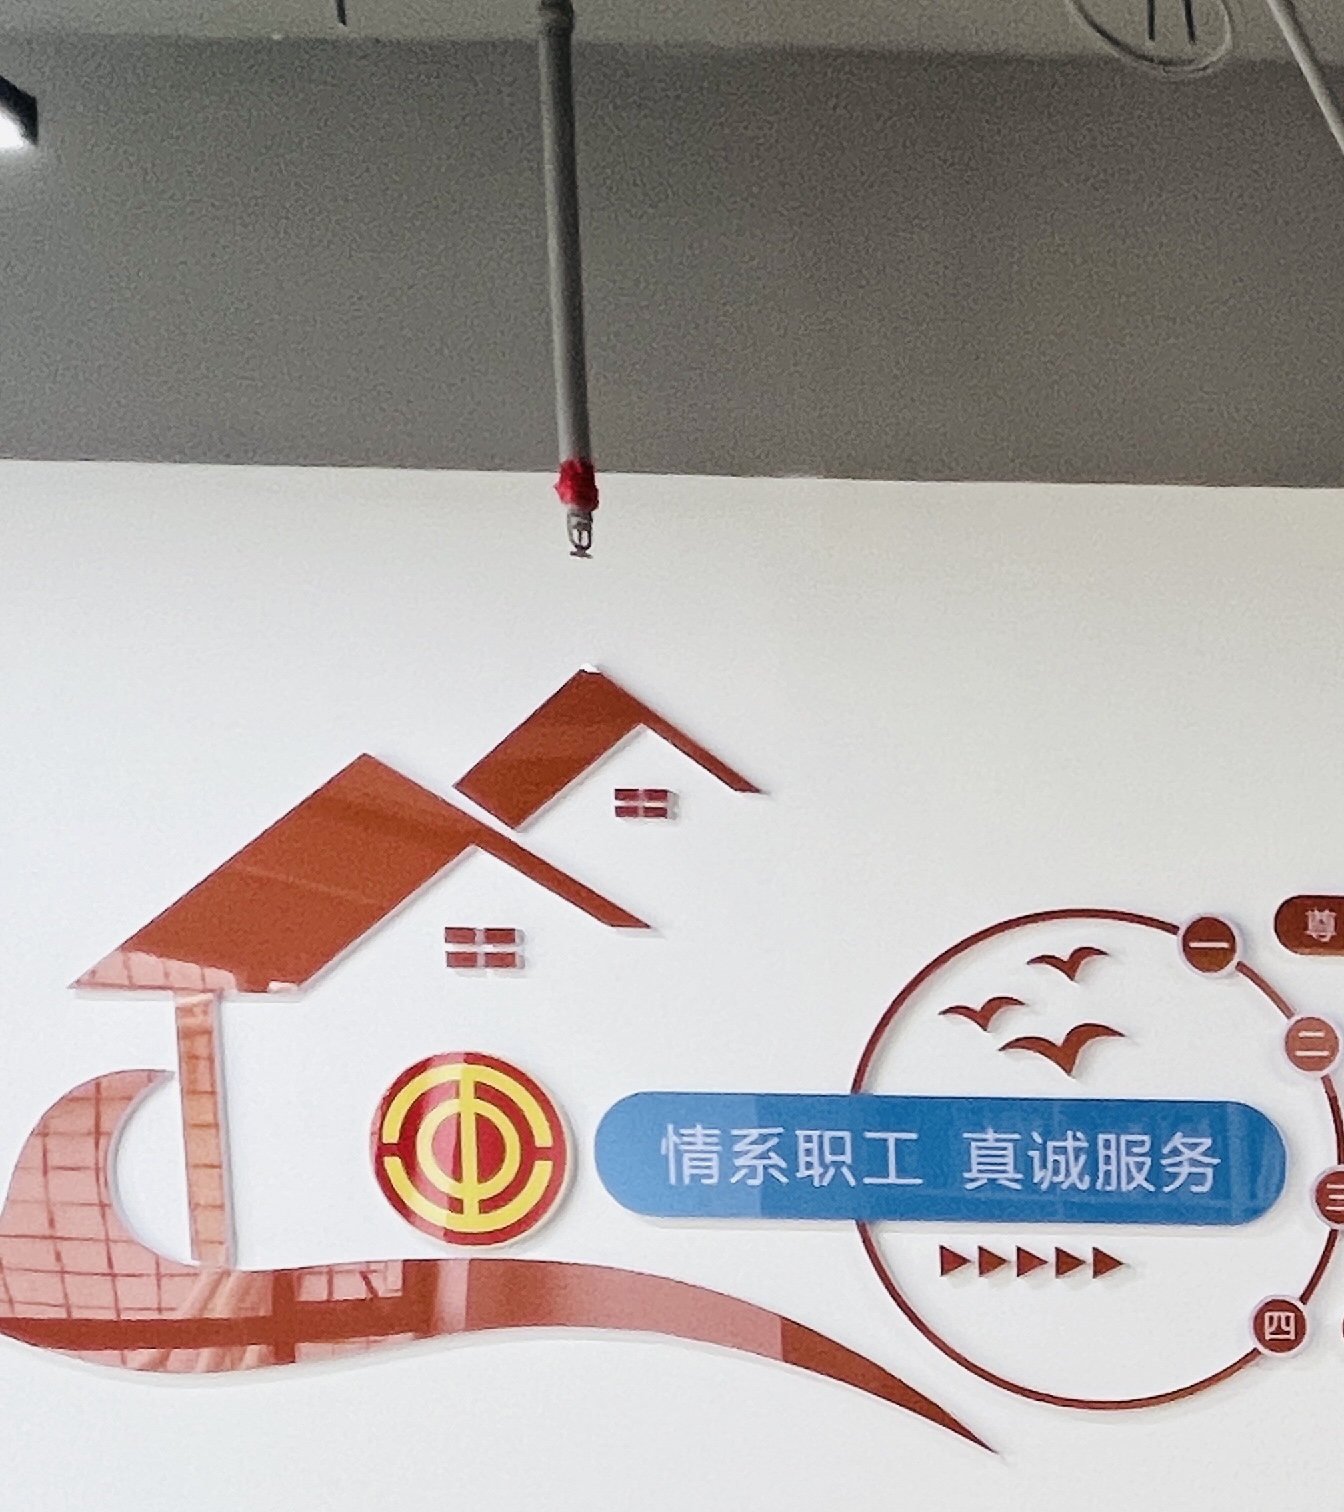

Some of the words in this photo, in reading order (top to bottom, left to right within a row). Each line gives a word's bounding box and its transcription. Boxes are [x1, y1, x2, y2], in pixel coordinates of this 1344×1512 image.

[1295, 1030, 1331, 1060] 二
[660, 1122, 925, 1189] 情系职工
[962, 1128, 1223, 1195] 真诚服务
[1263, 1310, 1297, 1341] 四
